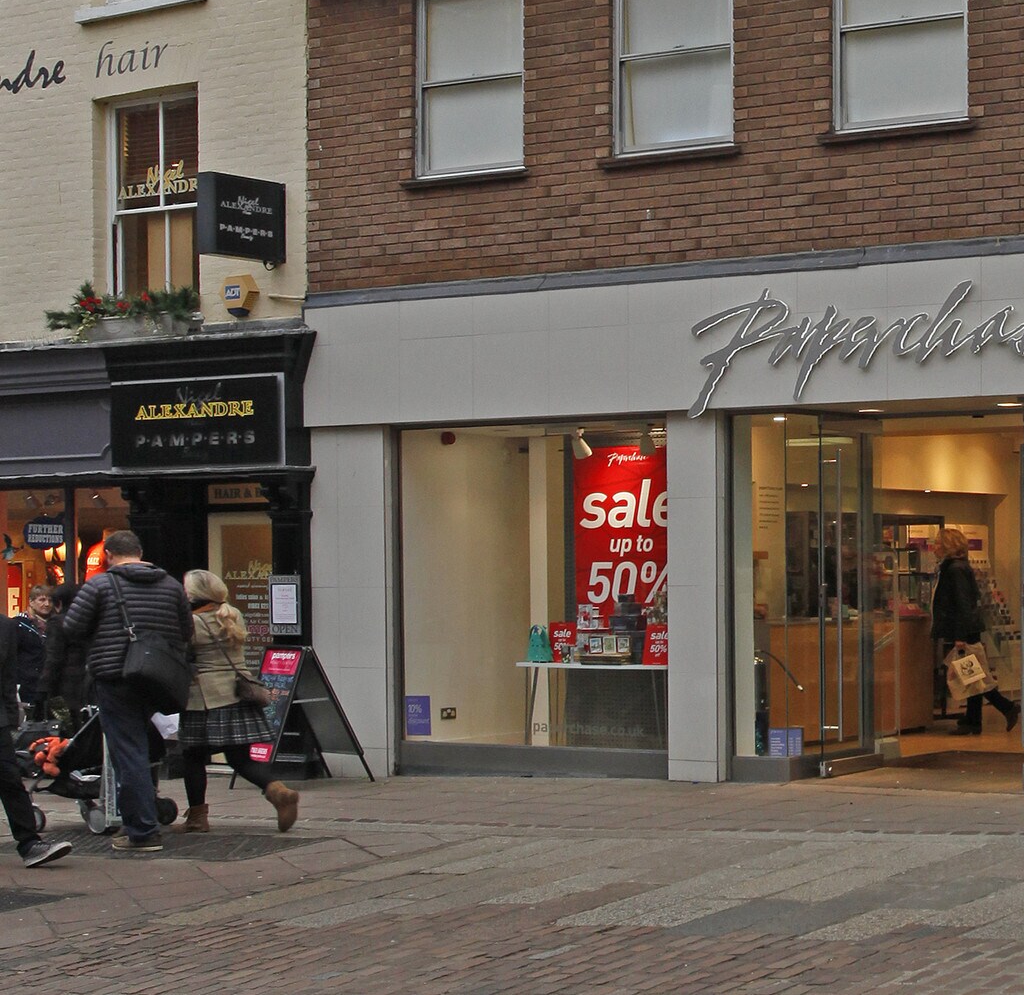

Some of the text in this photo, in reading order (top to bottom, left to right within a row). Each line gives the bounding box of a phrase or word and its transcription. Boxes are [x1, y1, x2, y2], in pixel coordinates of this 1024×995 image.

[0, 41, 168, 94] ndre hair
[118, 177, 198, 201] ALEXANDR
[220, 200, 273, 215] ALEXANDRE
[226, 287, 240, 297] ADT
[135, 400, 255, 420] ALEXANDRE
[214, 488, 241, 498] HAIR
[579, 478, 668, 529] sale
[28, 523, 64, 534] FURTHER
[28, 534, 64, 543] REDUCTIONS
[609, 534, 654, 557] up to
[587, 560, 668, 604] 50%
[272, 625, 298, 633] OPEN
[553, 629, 572, 638] sale
[271, 651, 296, 661] pampers
